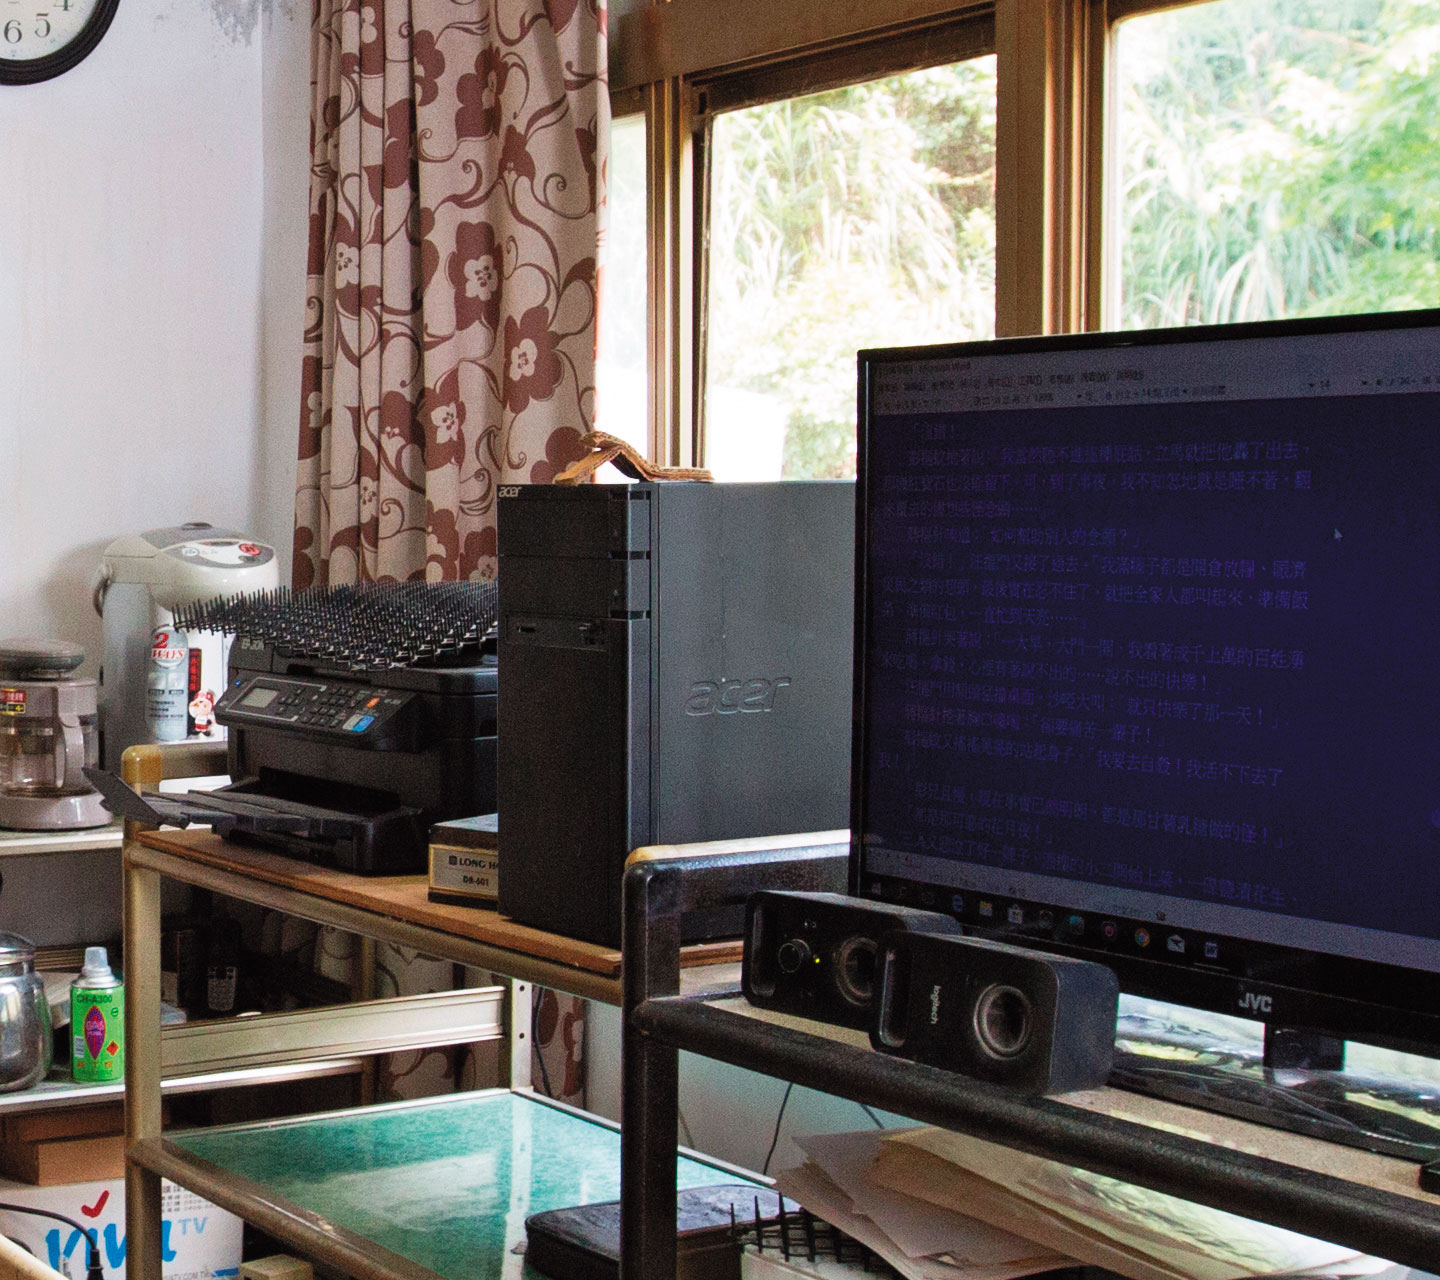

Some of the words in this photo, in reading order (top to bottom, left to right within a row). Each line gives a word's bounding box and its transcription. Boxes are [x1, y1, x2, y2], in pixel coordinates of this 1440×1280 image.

[3, 20, 22, 44] 6
[34, 13, 51, 38] 5
[498, 486, 522, 498] acer
[153, 632, 169, 649] 2
[686, 676, 792, 717] acer
[459, 857, 486, 869] LONG
[1238, 992, 1273, 1014] JVC
[178, 1218, 208, 1235] TV
